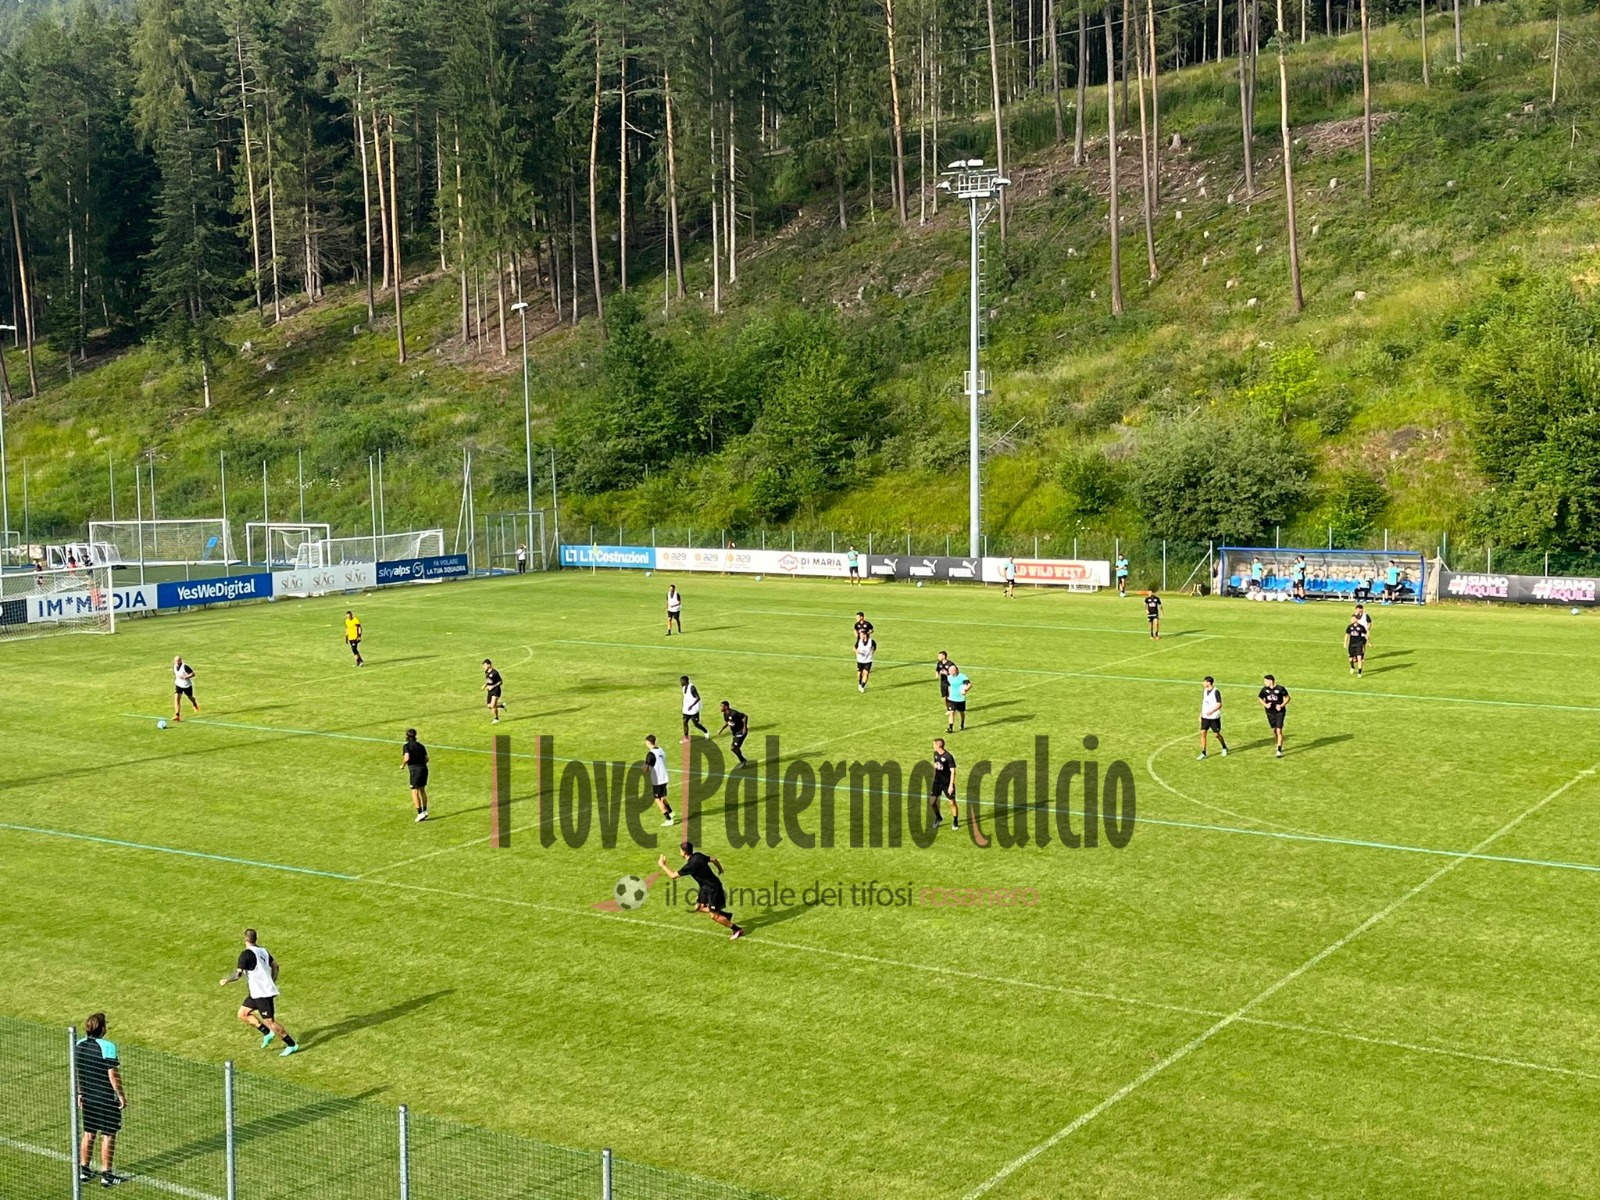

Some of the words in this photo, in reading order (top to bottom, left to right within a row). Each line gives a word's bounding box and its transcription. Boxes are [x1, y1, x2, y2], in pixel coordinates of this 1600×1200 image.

[595, 551, 649, 564] Costruzioni
[801, 557, 810, 565] DI
[813, 558, 842, 567] MARIA
[378, 565, 411, 578] skyalps
[1027, 565, 1052, 577] WILD
[1054, 566, 1083, 578] WEST
[177, 578, 256, 600] YesWeDigital
[1465, 585, 1508, 597] AQUILE
[1549, 588, 1595, 601] AQUILE
